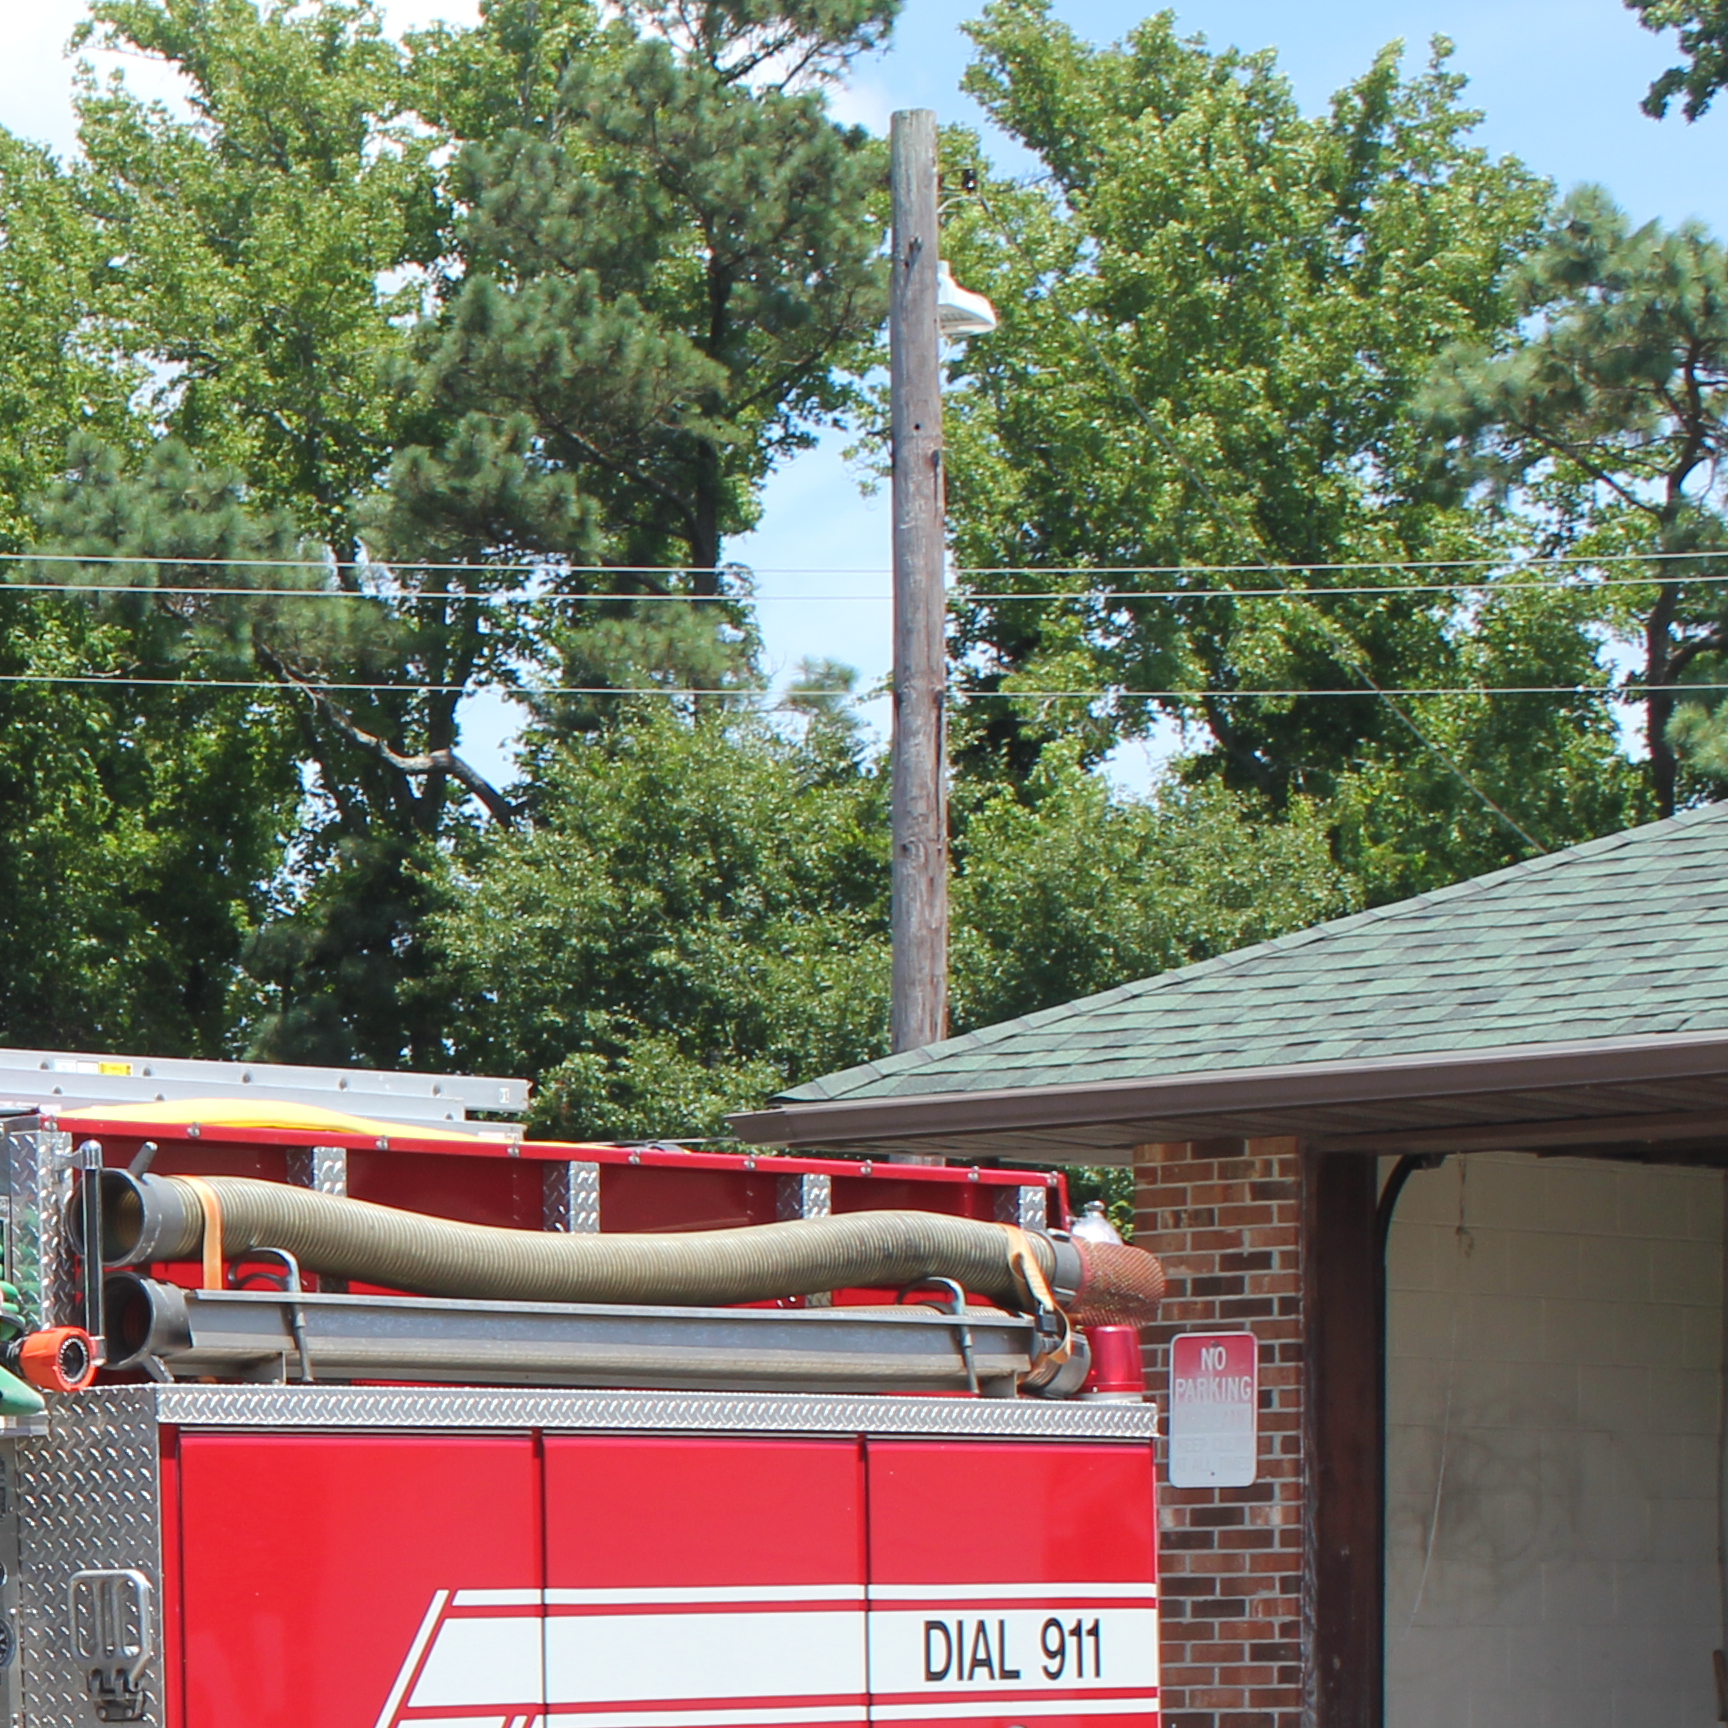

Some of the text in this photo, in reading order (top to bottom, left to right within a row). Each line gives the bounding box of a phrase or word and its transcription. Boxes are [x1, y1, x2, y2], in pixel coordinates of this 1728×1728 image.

[1201, 1347, 1227, 1371] NO
[1175, 1376, 1252, 1403] PARKING
[923, 1617, 1102, 1682] DIAL 911
